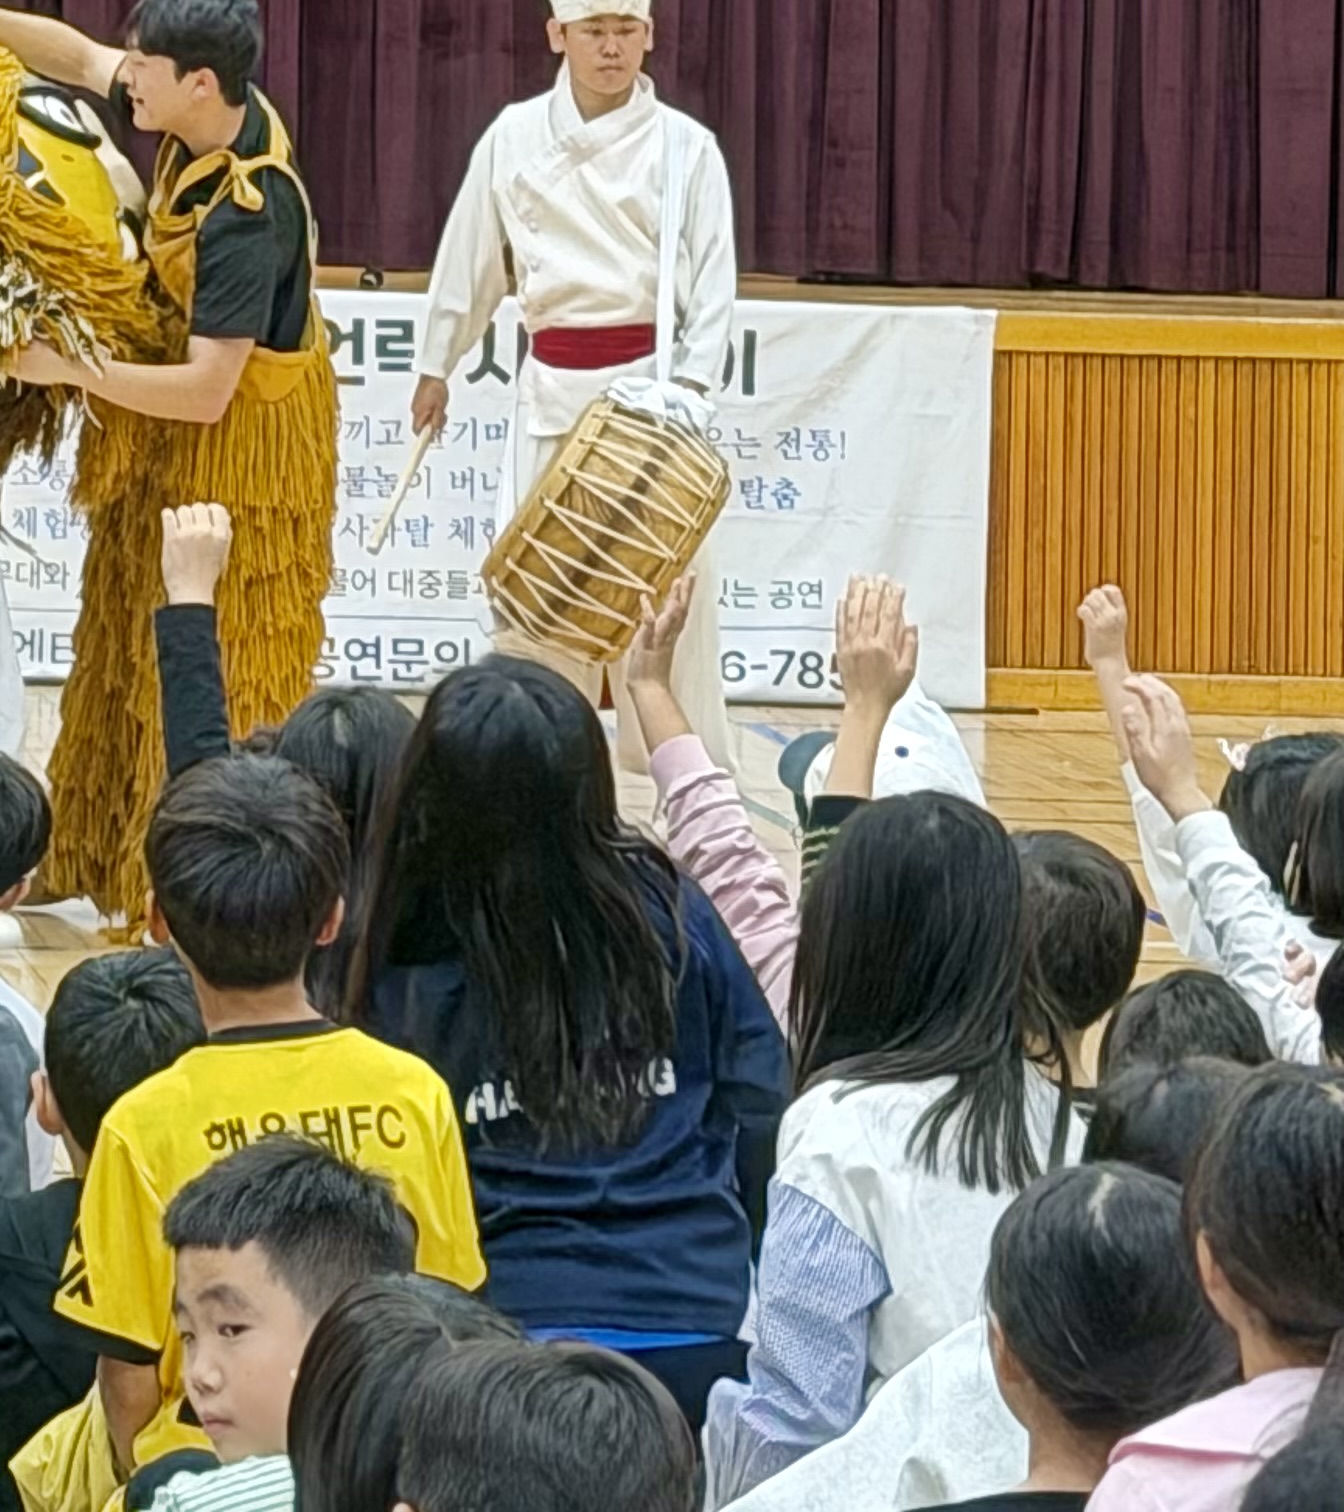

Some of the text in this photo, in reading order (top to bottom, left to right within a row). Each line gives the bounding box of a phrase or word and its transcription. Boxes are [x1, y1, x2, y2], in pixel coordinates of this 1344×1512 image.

[344, 415, 405, 450] 끼고
[774, 427, 847, 461] 전통!
[739, 476, 802, 510] 탈춤
[768, 579, 823, 610] 공연
